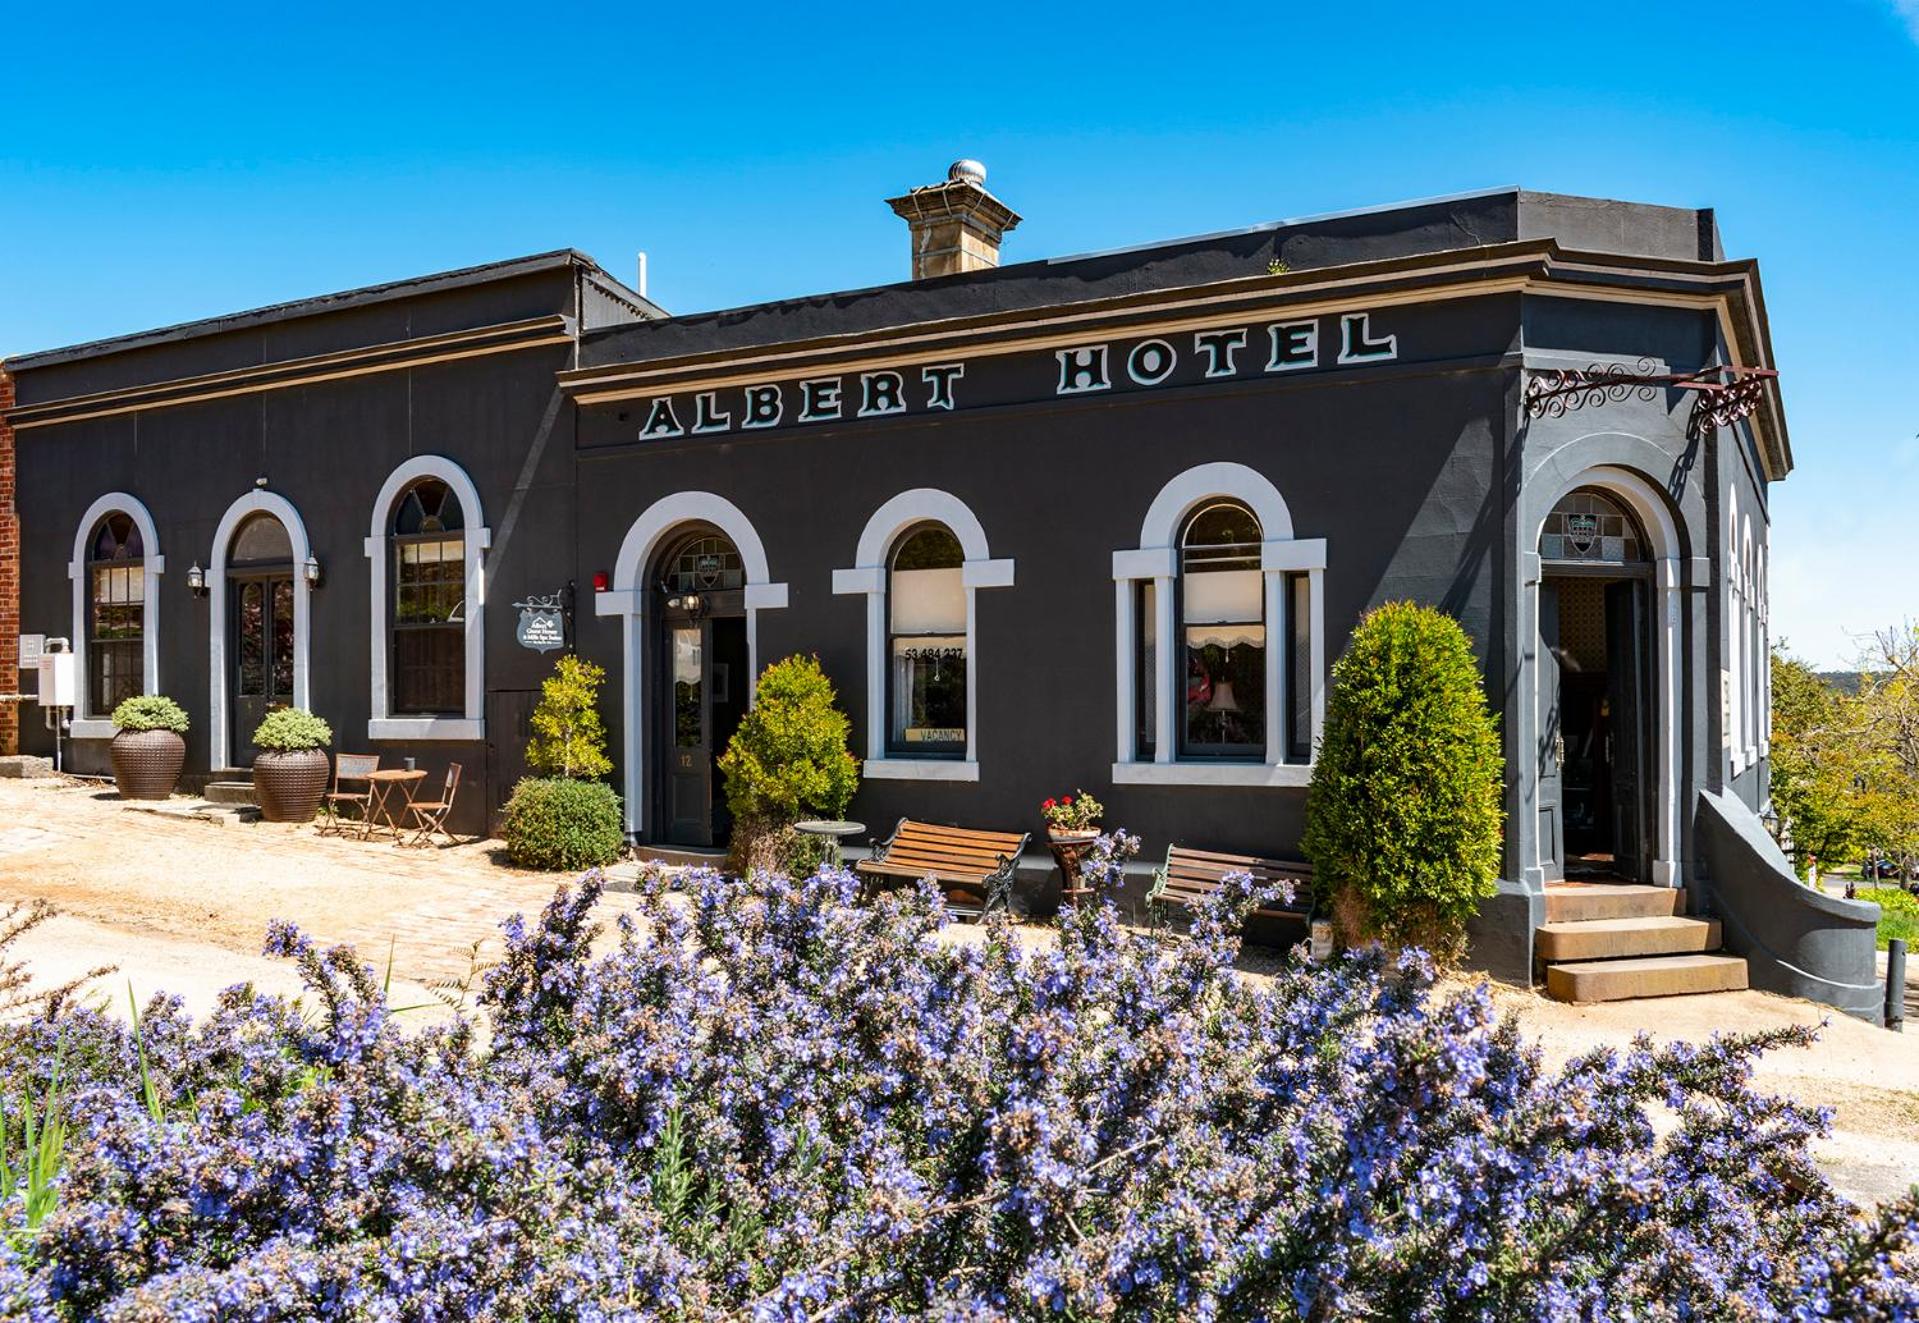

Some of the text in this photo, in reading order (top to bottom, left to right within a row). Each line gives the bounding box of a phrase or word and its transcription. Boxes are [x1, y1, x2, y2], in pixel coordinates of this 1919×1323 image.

[639, 313, 1398, 440] ALBERT HOTEL
[920, 729, 962, 741] VACANCY
[681, 754, 693, 767] 12
